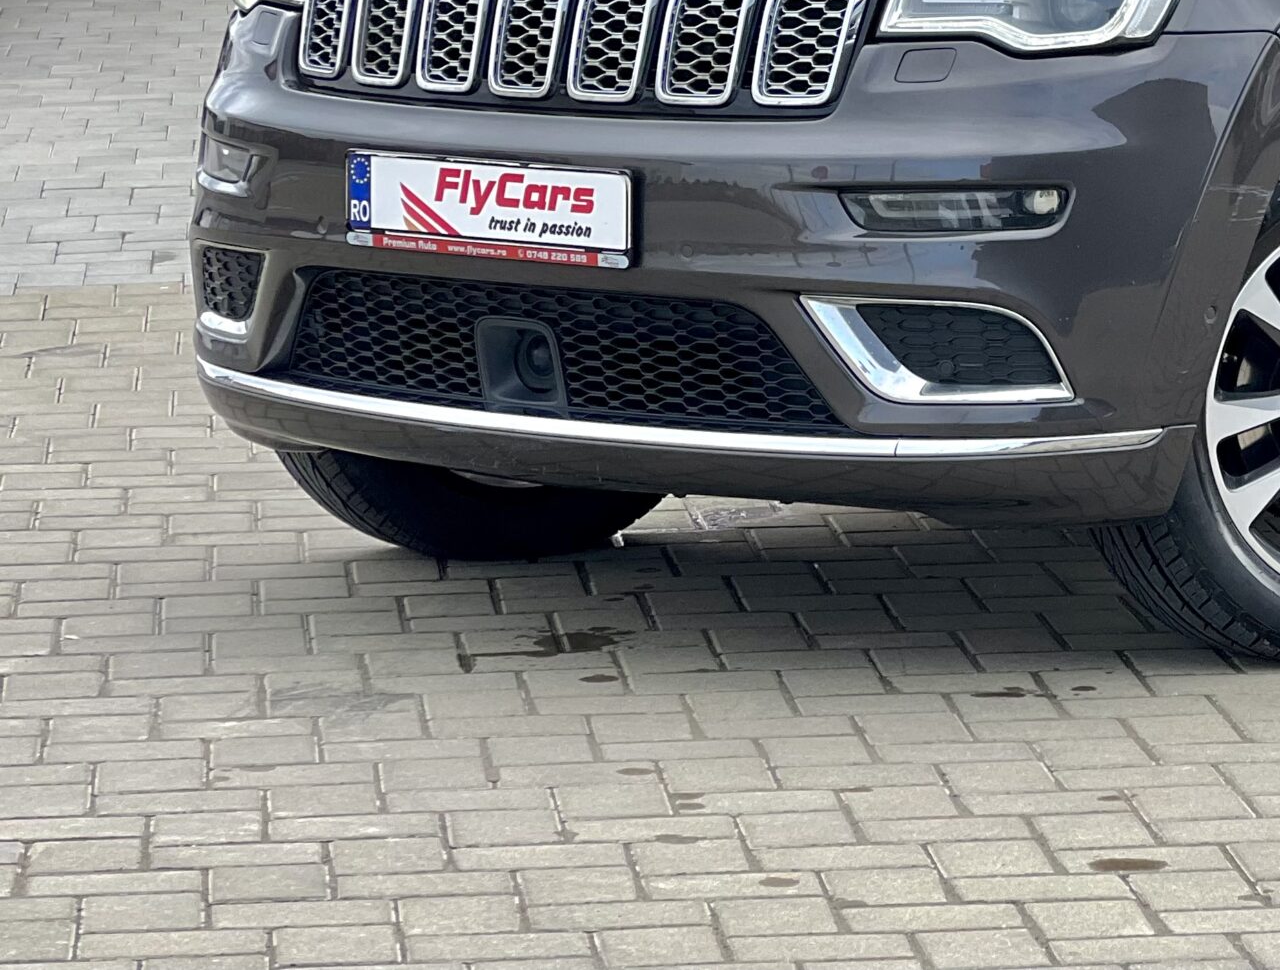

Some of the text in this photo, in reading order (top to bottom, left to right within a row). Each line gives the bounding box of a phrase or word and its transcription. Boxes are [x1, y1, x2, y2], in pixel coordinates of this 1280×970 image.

[434, 167, 595, 216] FlyCars
[350, 199, 370, 222] RO
[488, 216, 592, 238] trust in passion
[383, 237, 417, 249] Premium
[418, 240, 437, 251] Auto
[447, 244, 507, 257] www.flycars.ro
